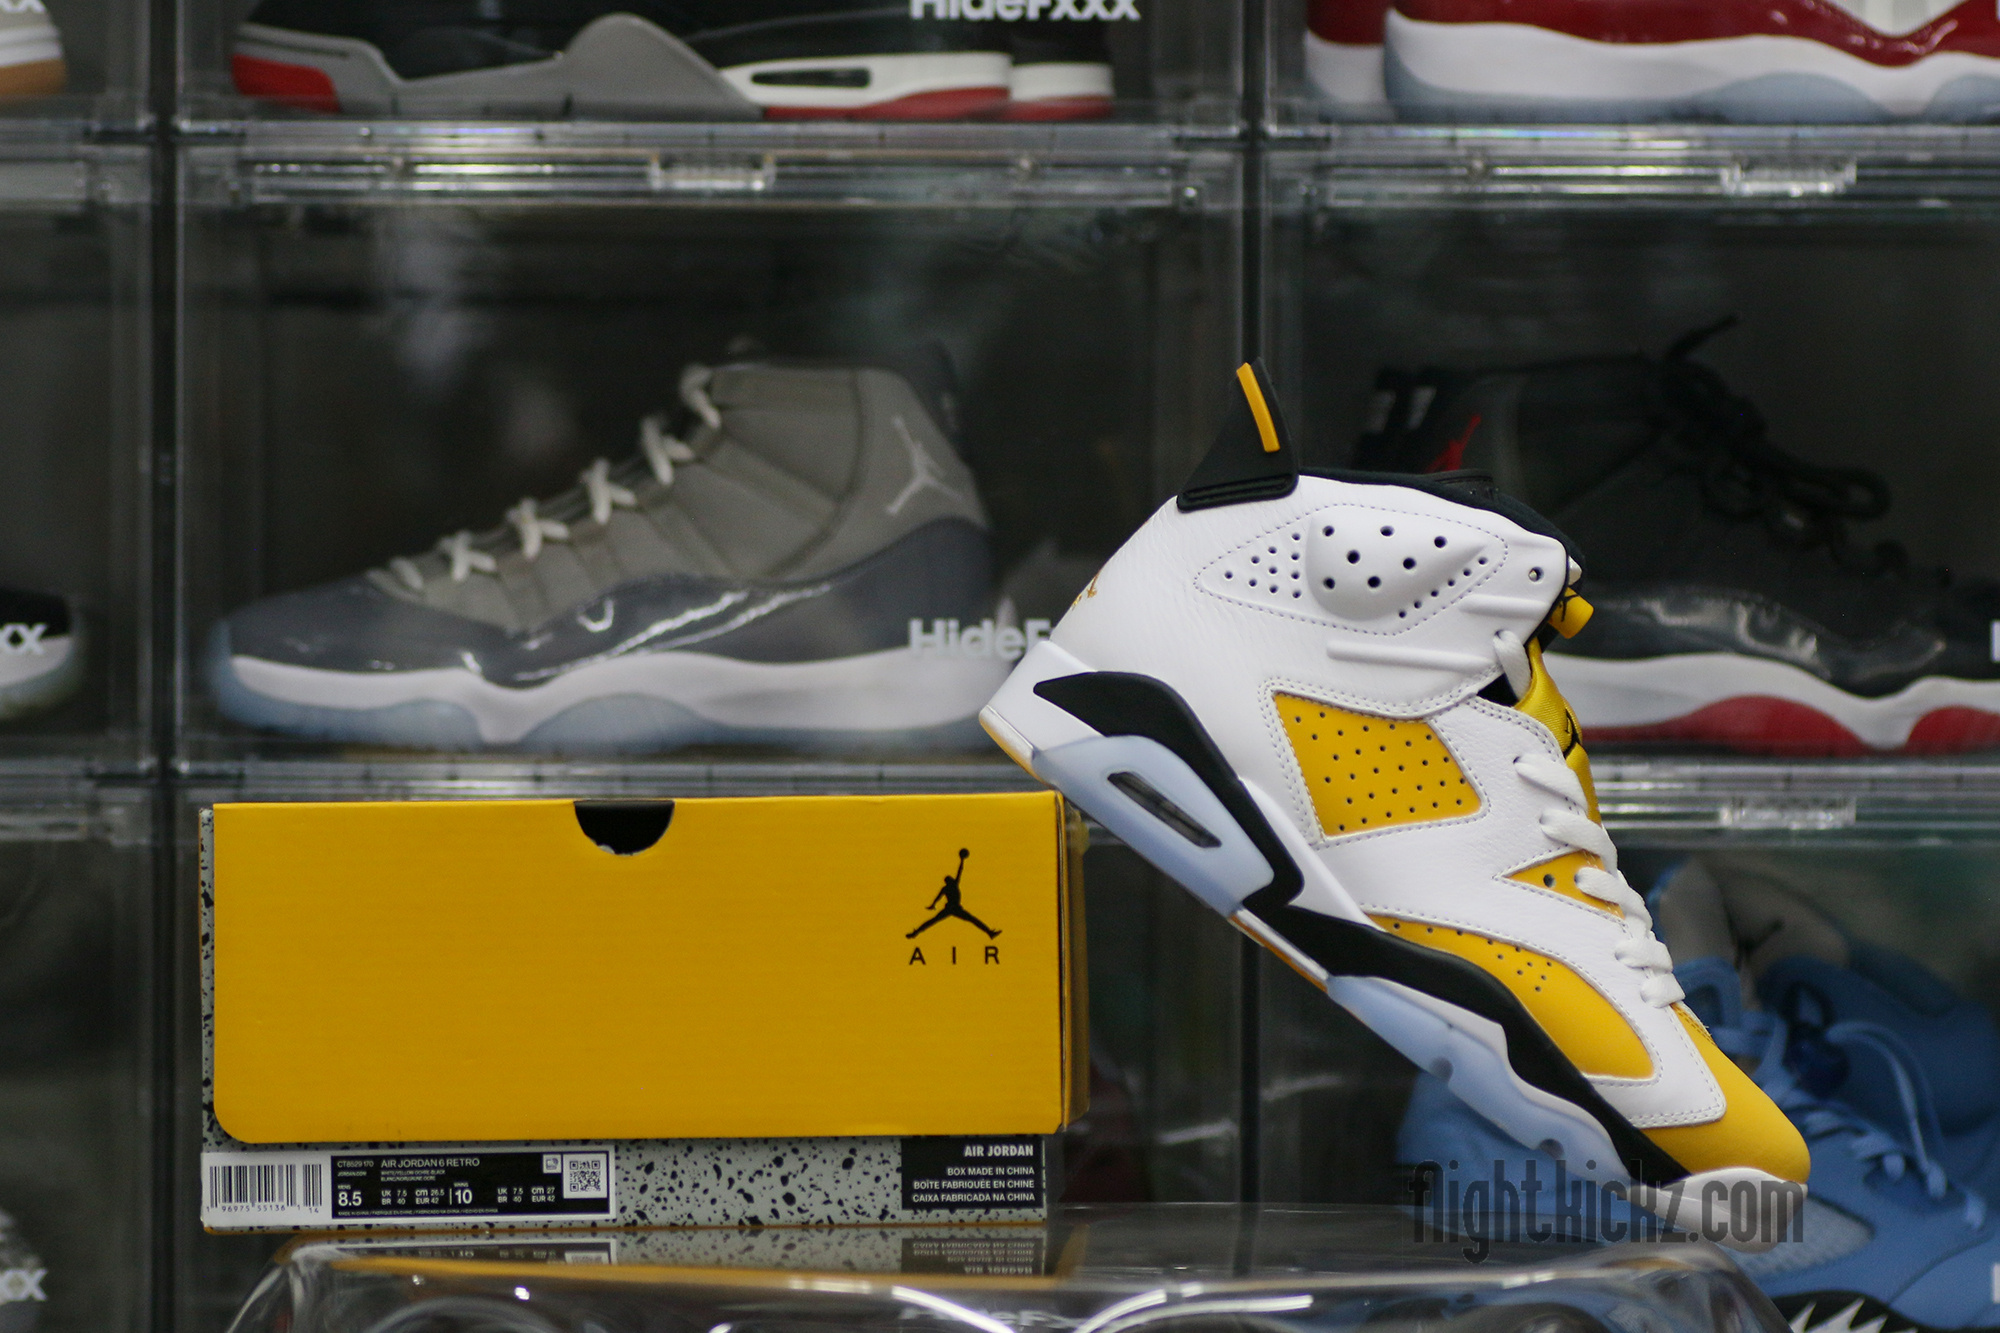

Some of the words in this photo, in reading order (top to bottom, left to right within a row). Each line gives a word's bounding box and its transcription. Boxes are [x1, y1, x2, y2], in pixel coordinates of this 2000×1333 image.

[909, 946, 1000, 965] AIR
[964, 1145, 984, 1157] AIR
[987, 1144, 1034, 1157] JORDAN
[380, 1159, 396, 1168] AIR
[398, 1158, 438, 1168] JORDAN
[438, 1158, 445, 1167] 6
[446, 1158, 480, 1167] RETRO
[947, 1167, 966, 1176] BOX
[968, 1167, 994, 1176] MADE
[995, 1166, 1005, 1175] IN
[1006, 1166, 1035, 1175] CHINA
[913, 1179, 940, 1190] BOÎTE
[942, 1179, 991, 1189] FABRIQUÉE
[993, 1180, 1006, 1189] EN
[1007, 1180, 1035, 1188] CHINE
[338, 1190, 362, 1206] 8.5
[455, 1189, 473, 1204] 10
[912, 1194, 940, 1202] CAIXA
[941, 1194, 991, 1202] FABRICADA
[993, 1193, 1005, 1202] NA
[1007, 1192, 1036, 1201] CHINA
